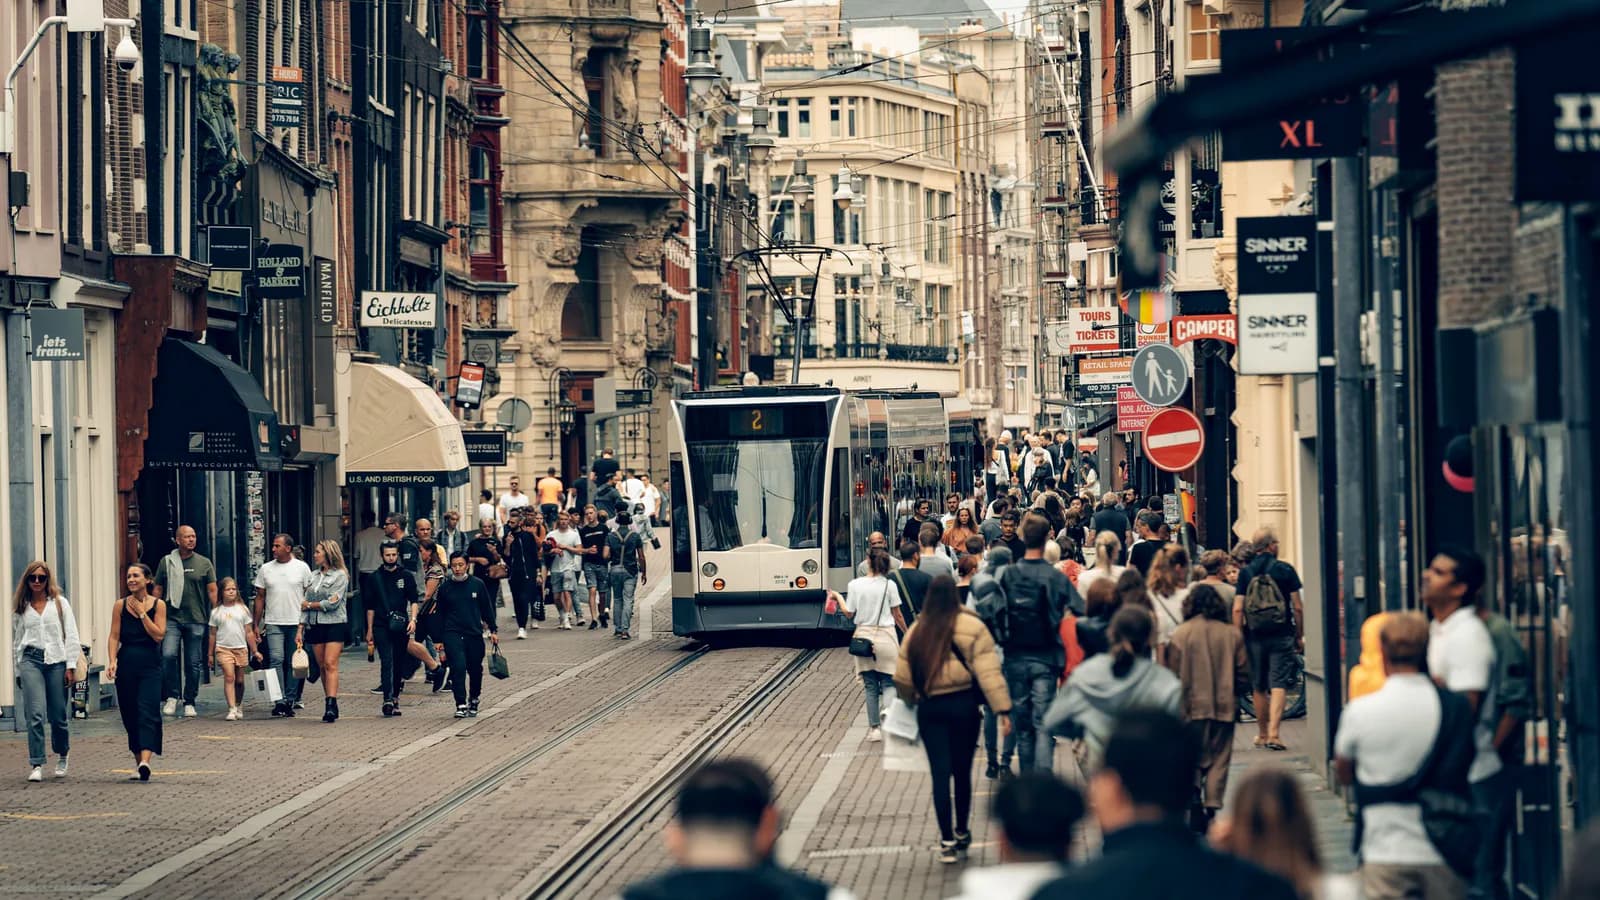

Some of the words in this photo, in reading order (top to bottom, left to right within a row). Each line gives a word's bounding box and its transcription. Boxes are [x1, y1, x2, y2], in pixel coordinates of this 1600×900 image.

[1279, 119, 1323, 149] XL
[1245, 237, 1308, 253] SINNER
[256, 257, 301, 268] HOLLAND
[276, 268, 285, 277] &
[258, 276, 301, 287] BARRETT
[320, 262, 333, 323] MANFIELD
[366, 295, 432, 319] Eichholtz
[382, 317, 432, 326] Delicatessen
[1079, 311, 1112, 321] TOURS
[1247, 314, 1308, 329] SINNER
[1075, 330, 1116, 341] TICKETS
[1176, 319, 1236, 341] CAMPER
[43, 334, 66, 347] iets
[36, 345, 81, 357] frans...
[751, 409, 762, 430] 2
[349, 475, 363, 483] U.S.
[364, 475, 381, 483] AND
[382, 475, 412, 483] BRITISH
[413, 475, 435, 483] FOOD
